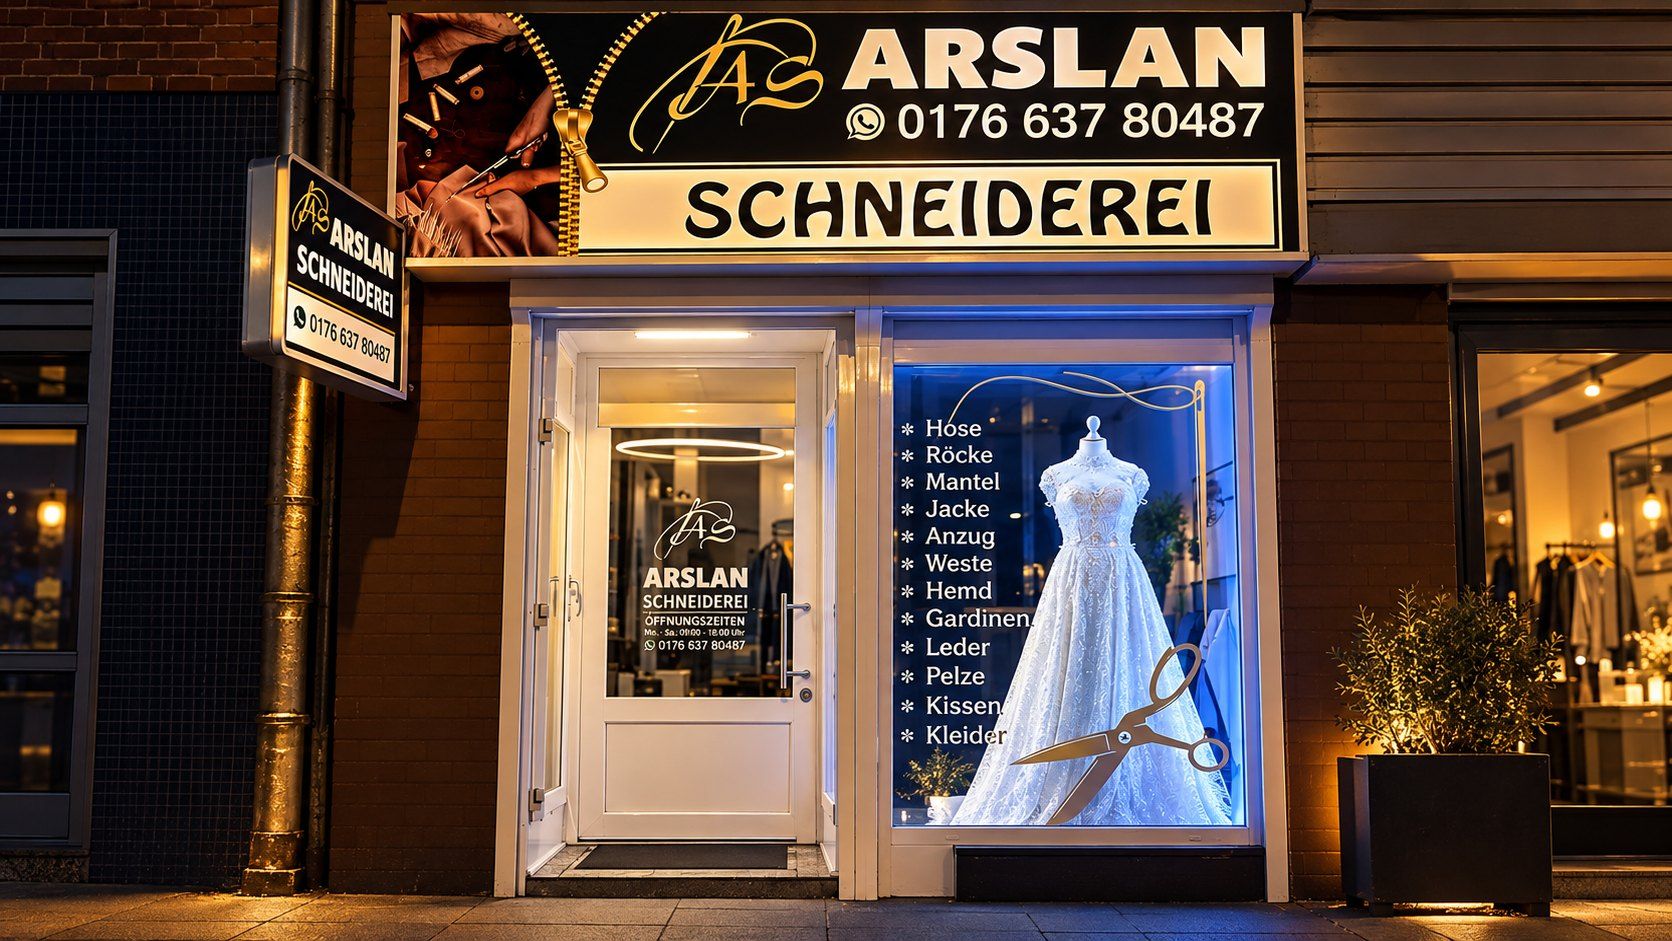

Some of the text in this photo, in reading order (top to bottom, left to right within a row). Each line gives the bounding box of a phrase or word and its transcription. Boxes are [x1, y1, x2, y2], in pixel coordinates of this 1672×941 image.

[842, 26, 1266, 89] ARSLAN
[898, 102, 1265, 140] 0176 637 80487
[685, 178, 1213, 238] SCHNEIDEREI
[330, 217, 394, 279] ARSLAN
[297, 244, 394, 318] SCHNEIDEREI
[310, 314, 390, 363] 0176 637 80487
[926, 419, 982, 437] Hose
[926, 445, 993, 464] Röcke
[926, 472, 1000, 491] Mantel
[925, 499, 990, 518] Jacke
[925, 526, 995, 550] Anzug
[925, 553, 993, 572] Weste
[643, 567, 748, 588] ARSLAN
[926, 580, 992, 600] Hemd
[643, 594, 748, 609] SCHNEIDEREI
[645, 612, 745, 626] ÖFFNUNGSZEITEN
[926, 608, 1031, 628] Gardinen
[658, 640, 746, 651] 0176 637 80487
[926, 636, 991, 656] Leder
[926, 666, 985, 686] Pelze
[926, 695, 1002, 715] Kissen
[926, 725, 1008, 745] Kleider
